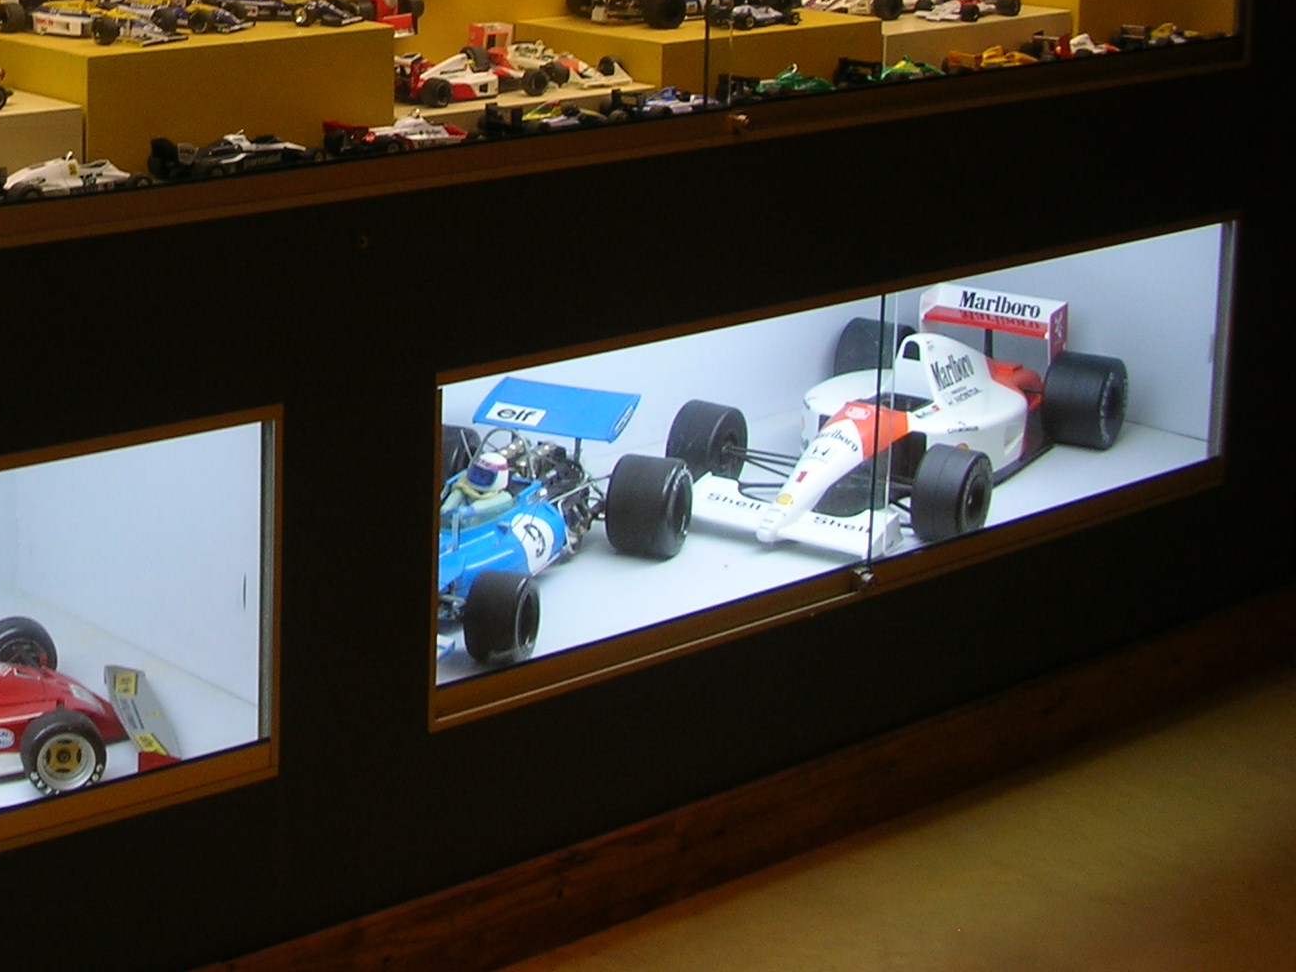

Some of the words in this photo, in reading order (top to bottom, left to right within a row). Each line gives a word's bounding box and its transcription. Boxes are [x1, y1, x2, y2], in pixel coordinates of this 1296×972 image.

[959, 289, 1041, 319] Marlboro
[930, 354, 975, 392] Marlboro
[497, 407, 538, 423] elf
[707, 492, 762, 511] Shell
